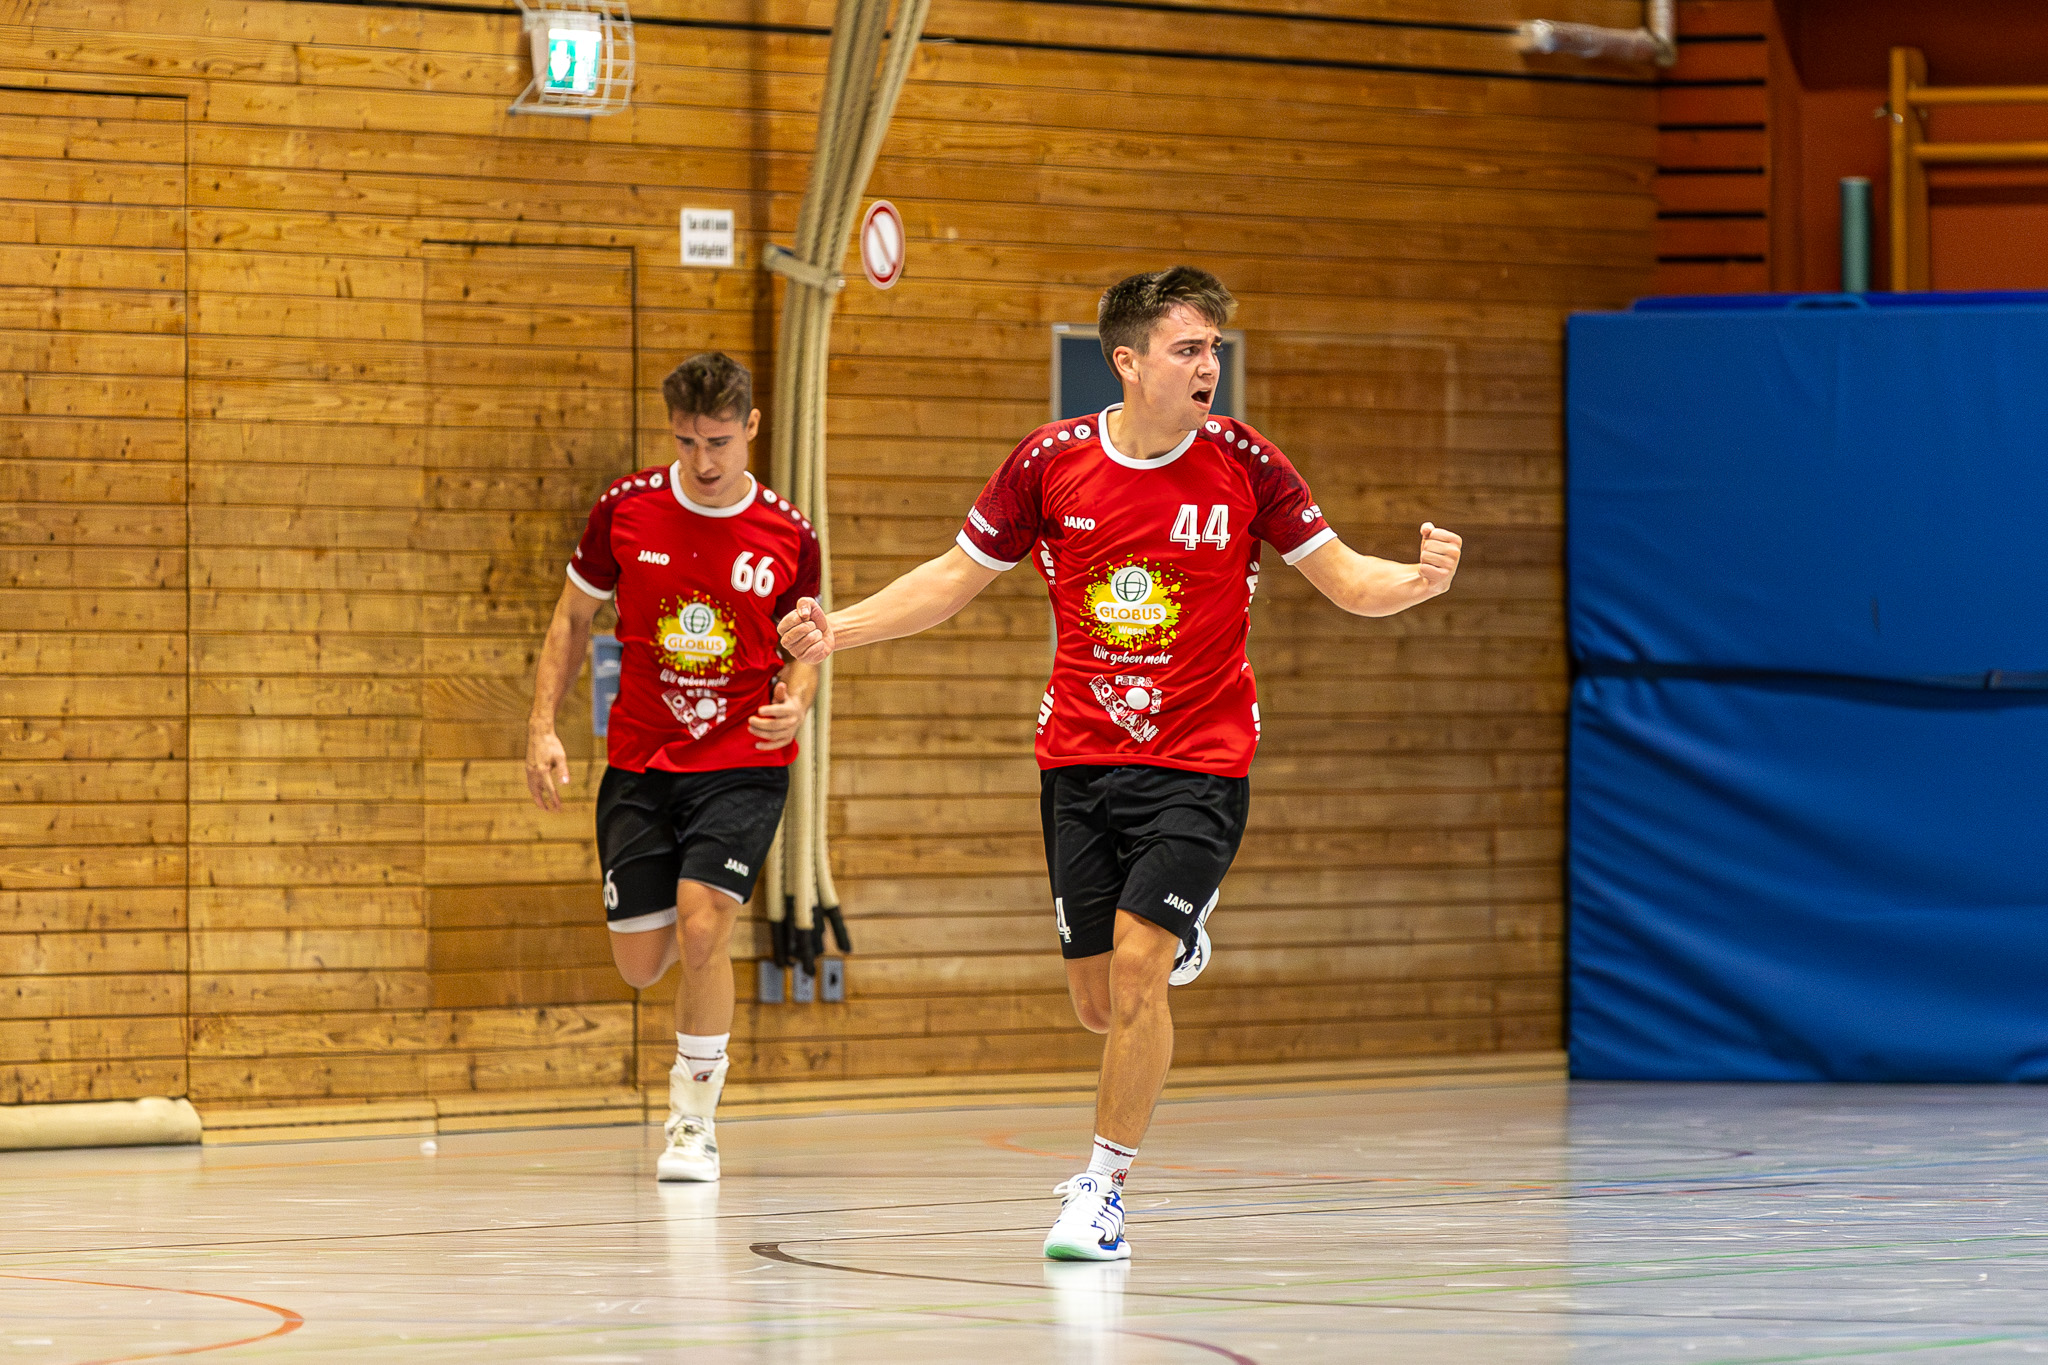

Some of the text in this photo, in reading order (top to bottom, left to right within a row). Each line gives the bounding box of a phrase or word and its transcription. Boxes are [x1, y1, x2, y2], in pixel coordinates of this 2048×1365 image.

[1063, 515, 1096, 531] JAKO
[1169, 504, 1231, 551] 44
[637, 549, 670, 566] JAKO
[731, 551, 775, 598] 66
[1099, 606, 1162, 621] GLOBUS
[1118, 625, 1147, 635] Wesel
[668, 637, 722, 652] GLOBUS
[1093, 644, 1173, 666] Wir geben mehr
[723, 858, 750, 877] JAKO
[1163, 892, 1194, 915] JAKO
